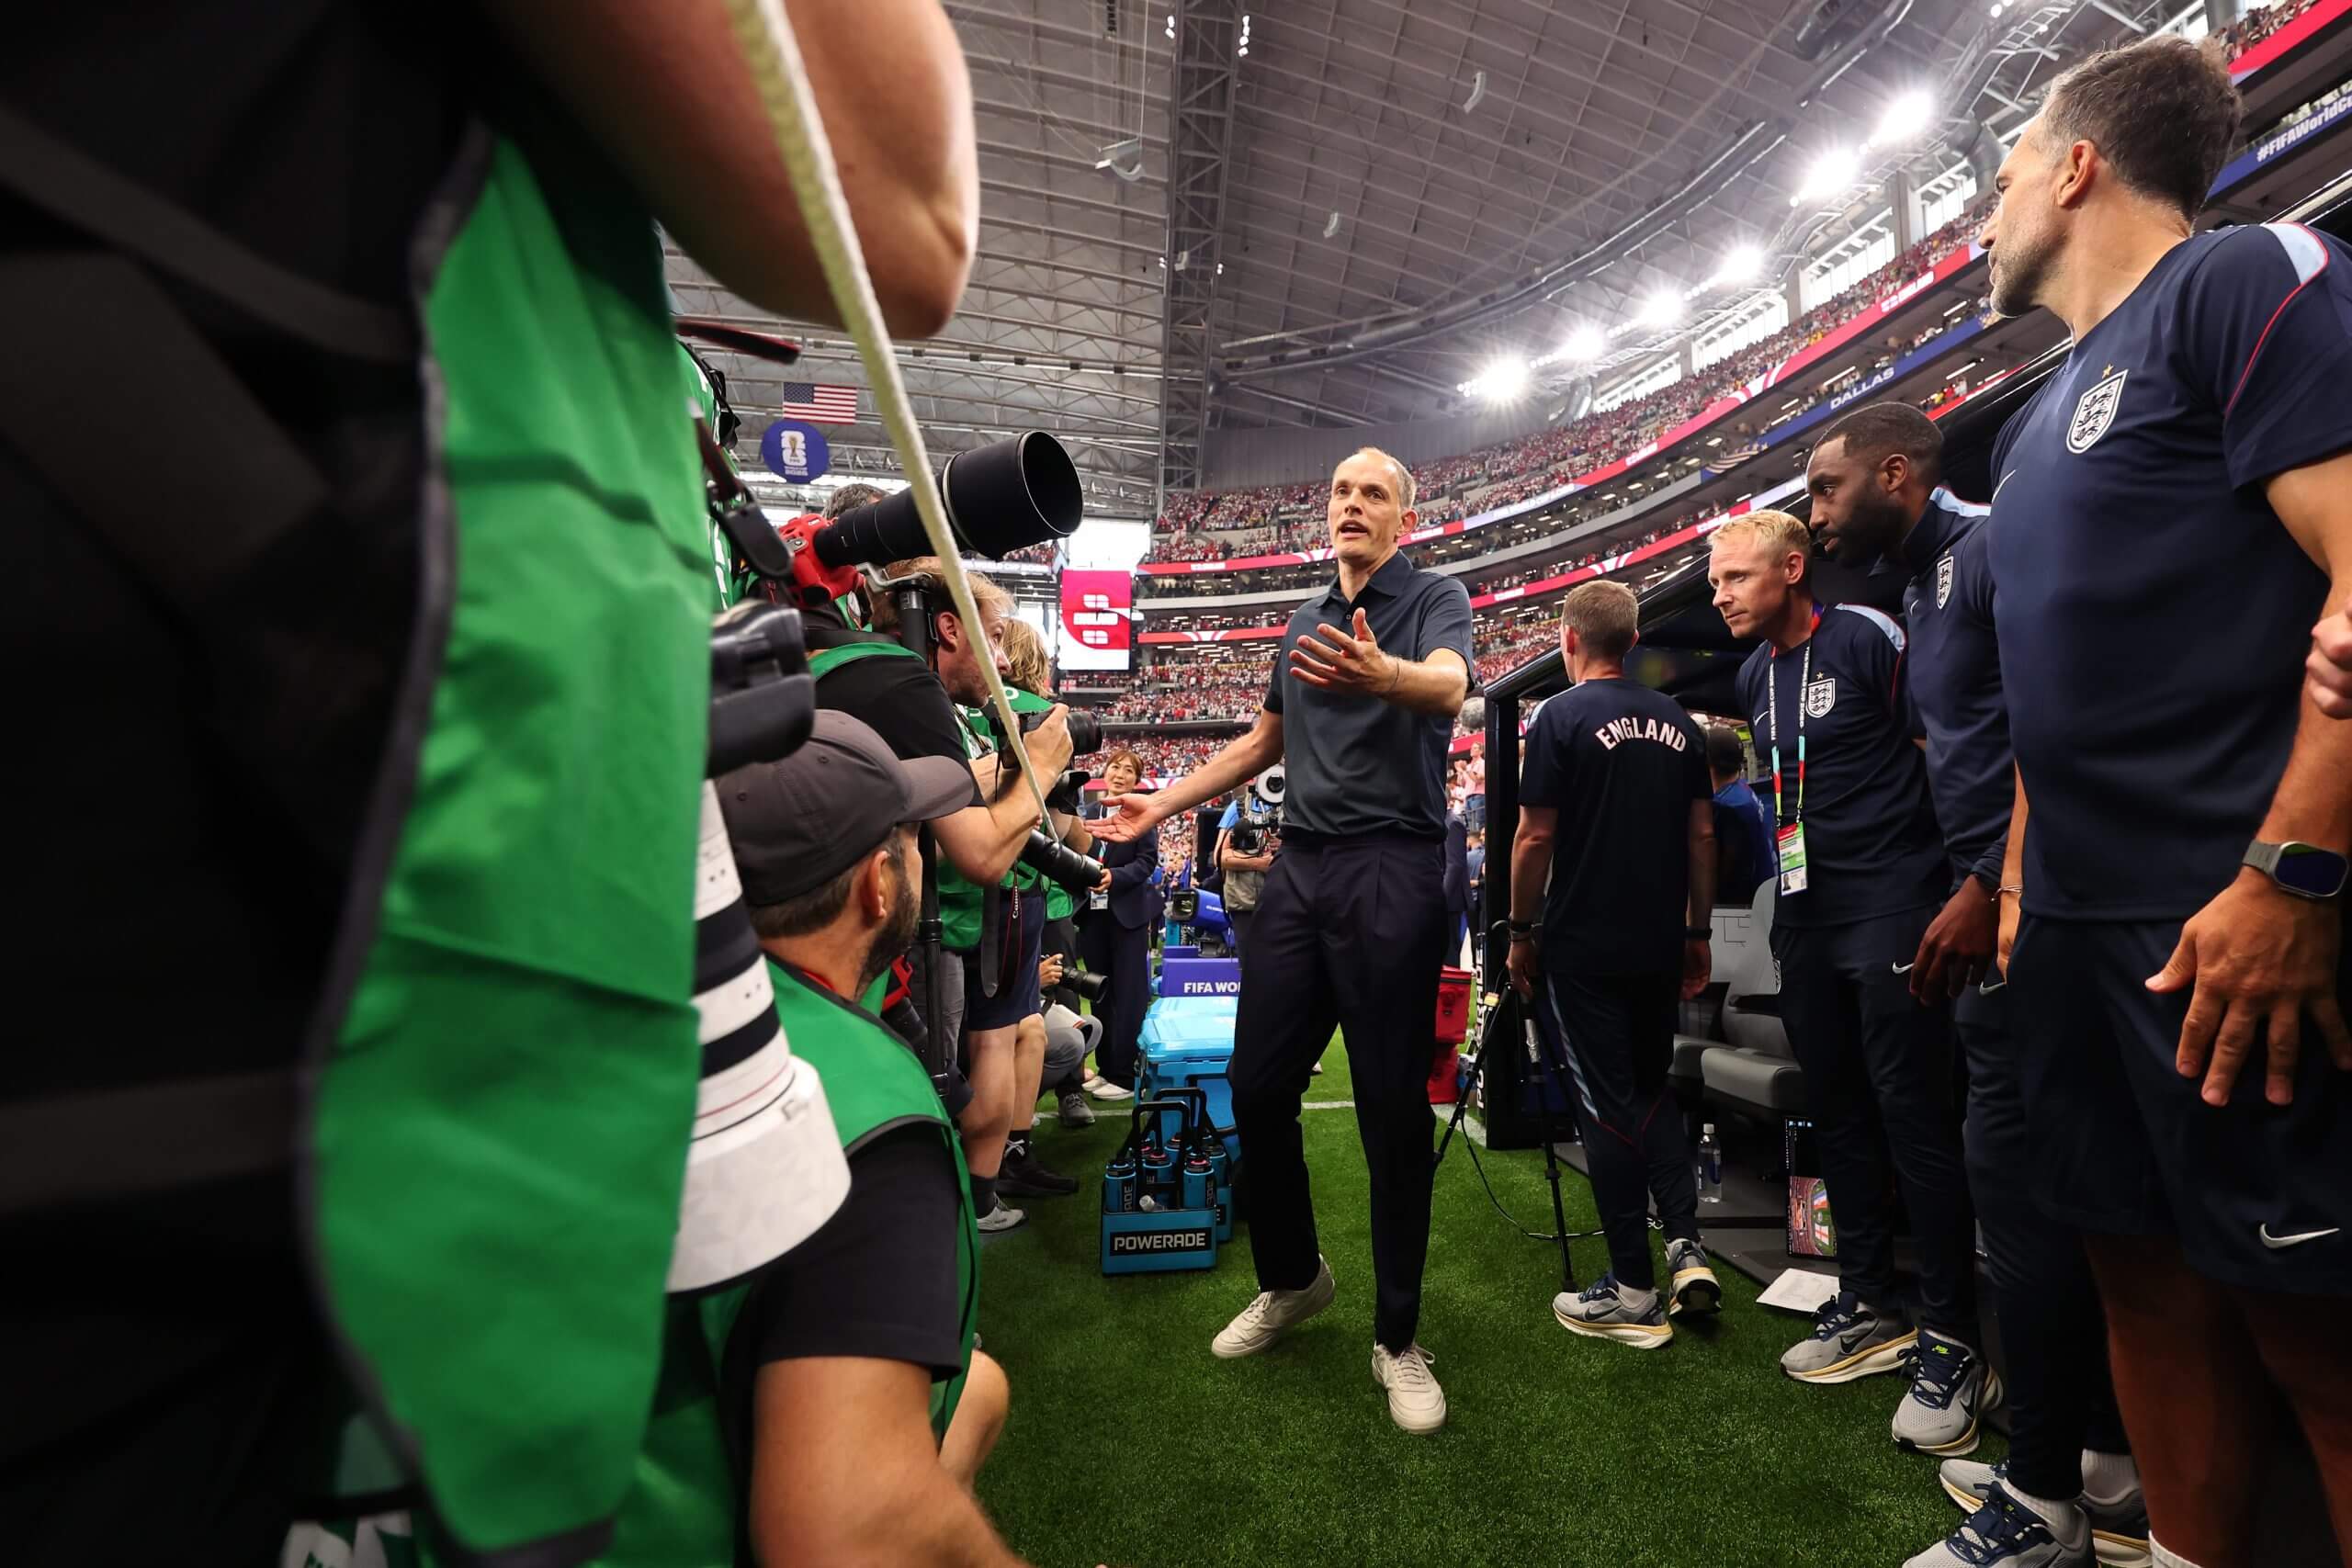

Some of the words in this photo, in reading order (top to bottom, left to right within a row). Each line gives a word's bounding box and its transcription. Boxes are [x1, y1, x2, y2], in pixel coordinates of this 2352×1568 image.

[1830, 367, 1894, 410] DALLAS
[1595, 716, 1687, 751] ENGLAND
[1183, 981, 1213, 993] FIFA
[1114, 1232, 1206, 1251] POWERADE
